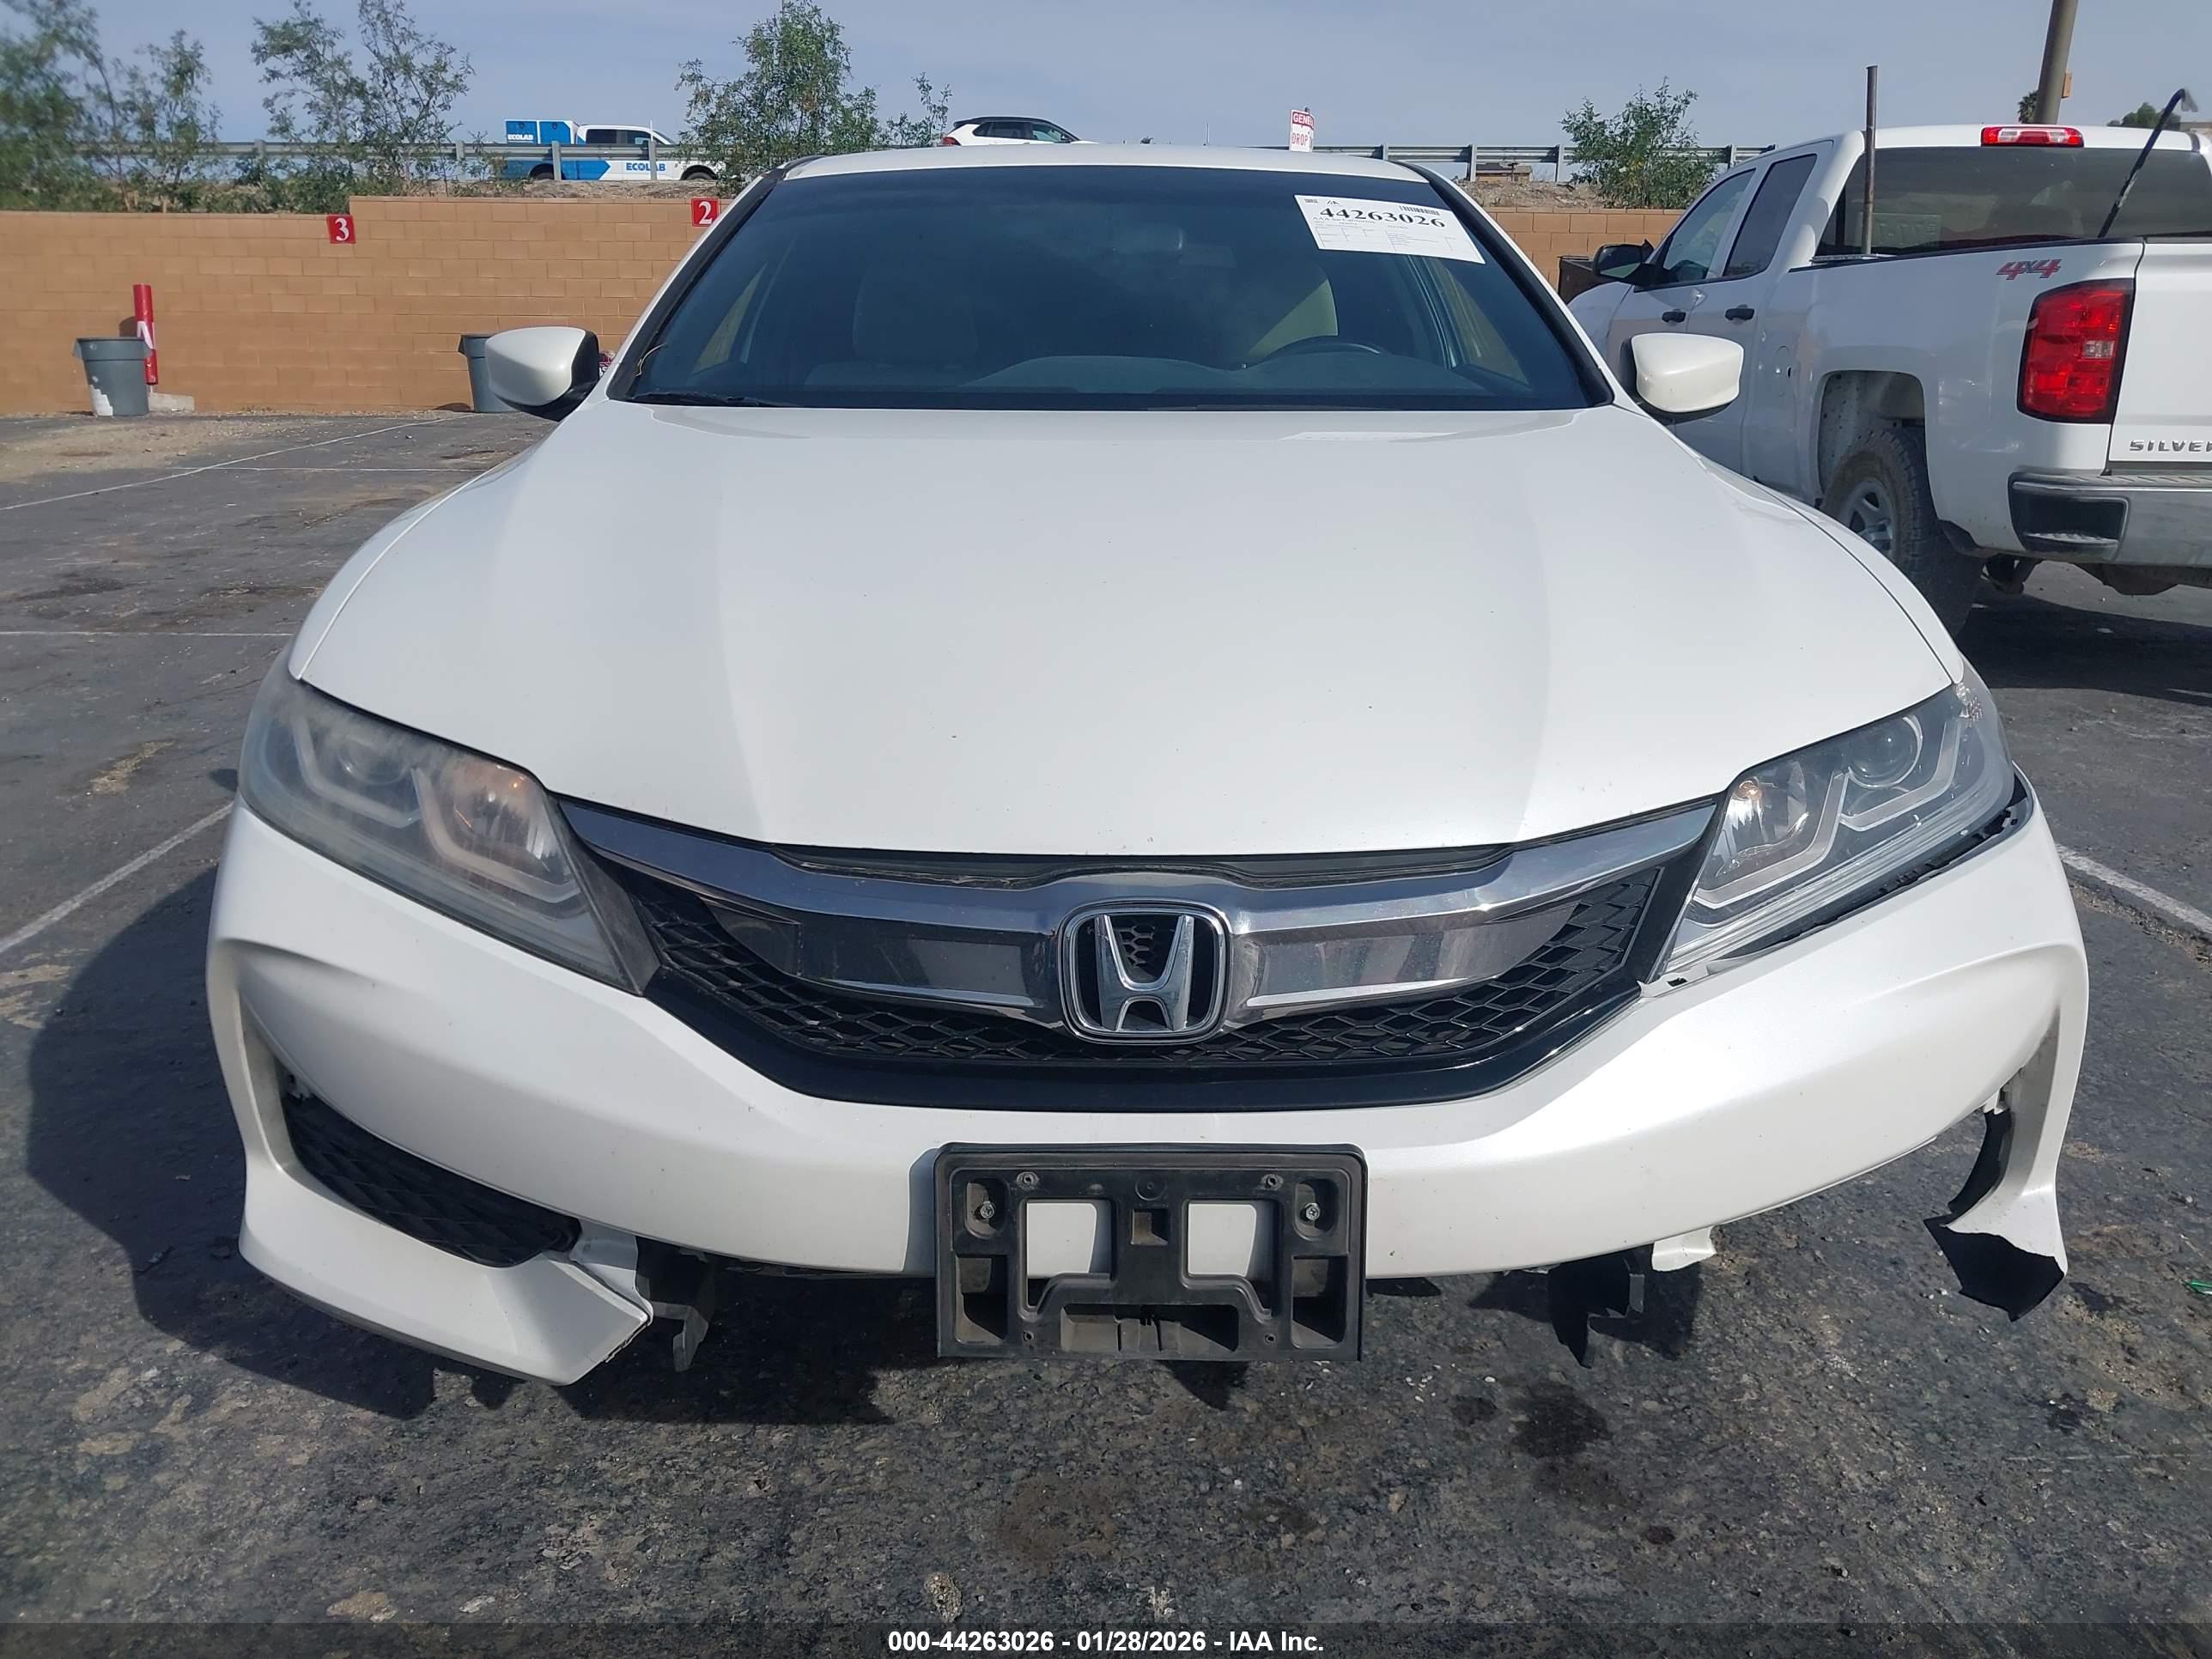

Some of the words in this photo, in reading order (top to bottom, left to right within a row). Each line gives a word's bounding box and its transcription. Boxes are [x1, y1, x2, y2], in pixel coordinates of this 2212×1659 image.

[626, 162, 665, 172] ECOLB
[698, 201, 713, 225] 2
[1320, 208, 1445, 228] 44263026
[335, 217, 349, 241] 3
